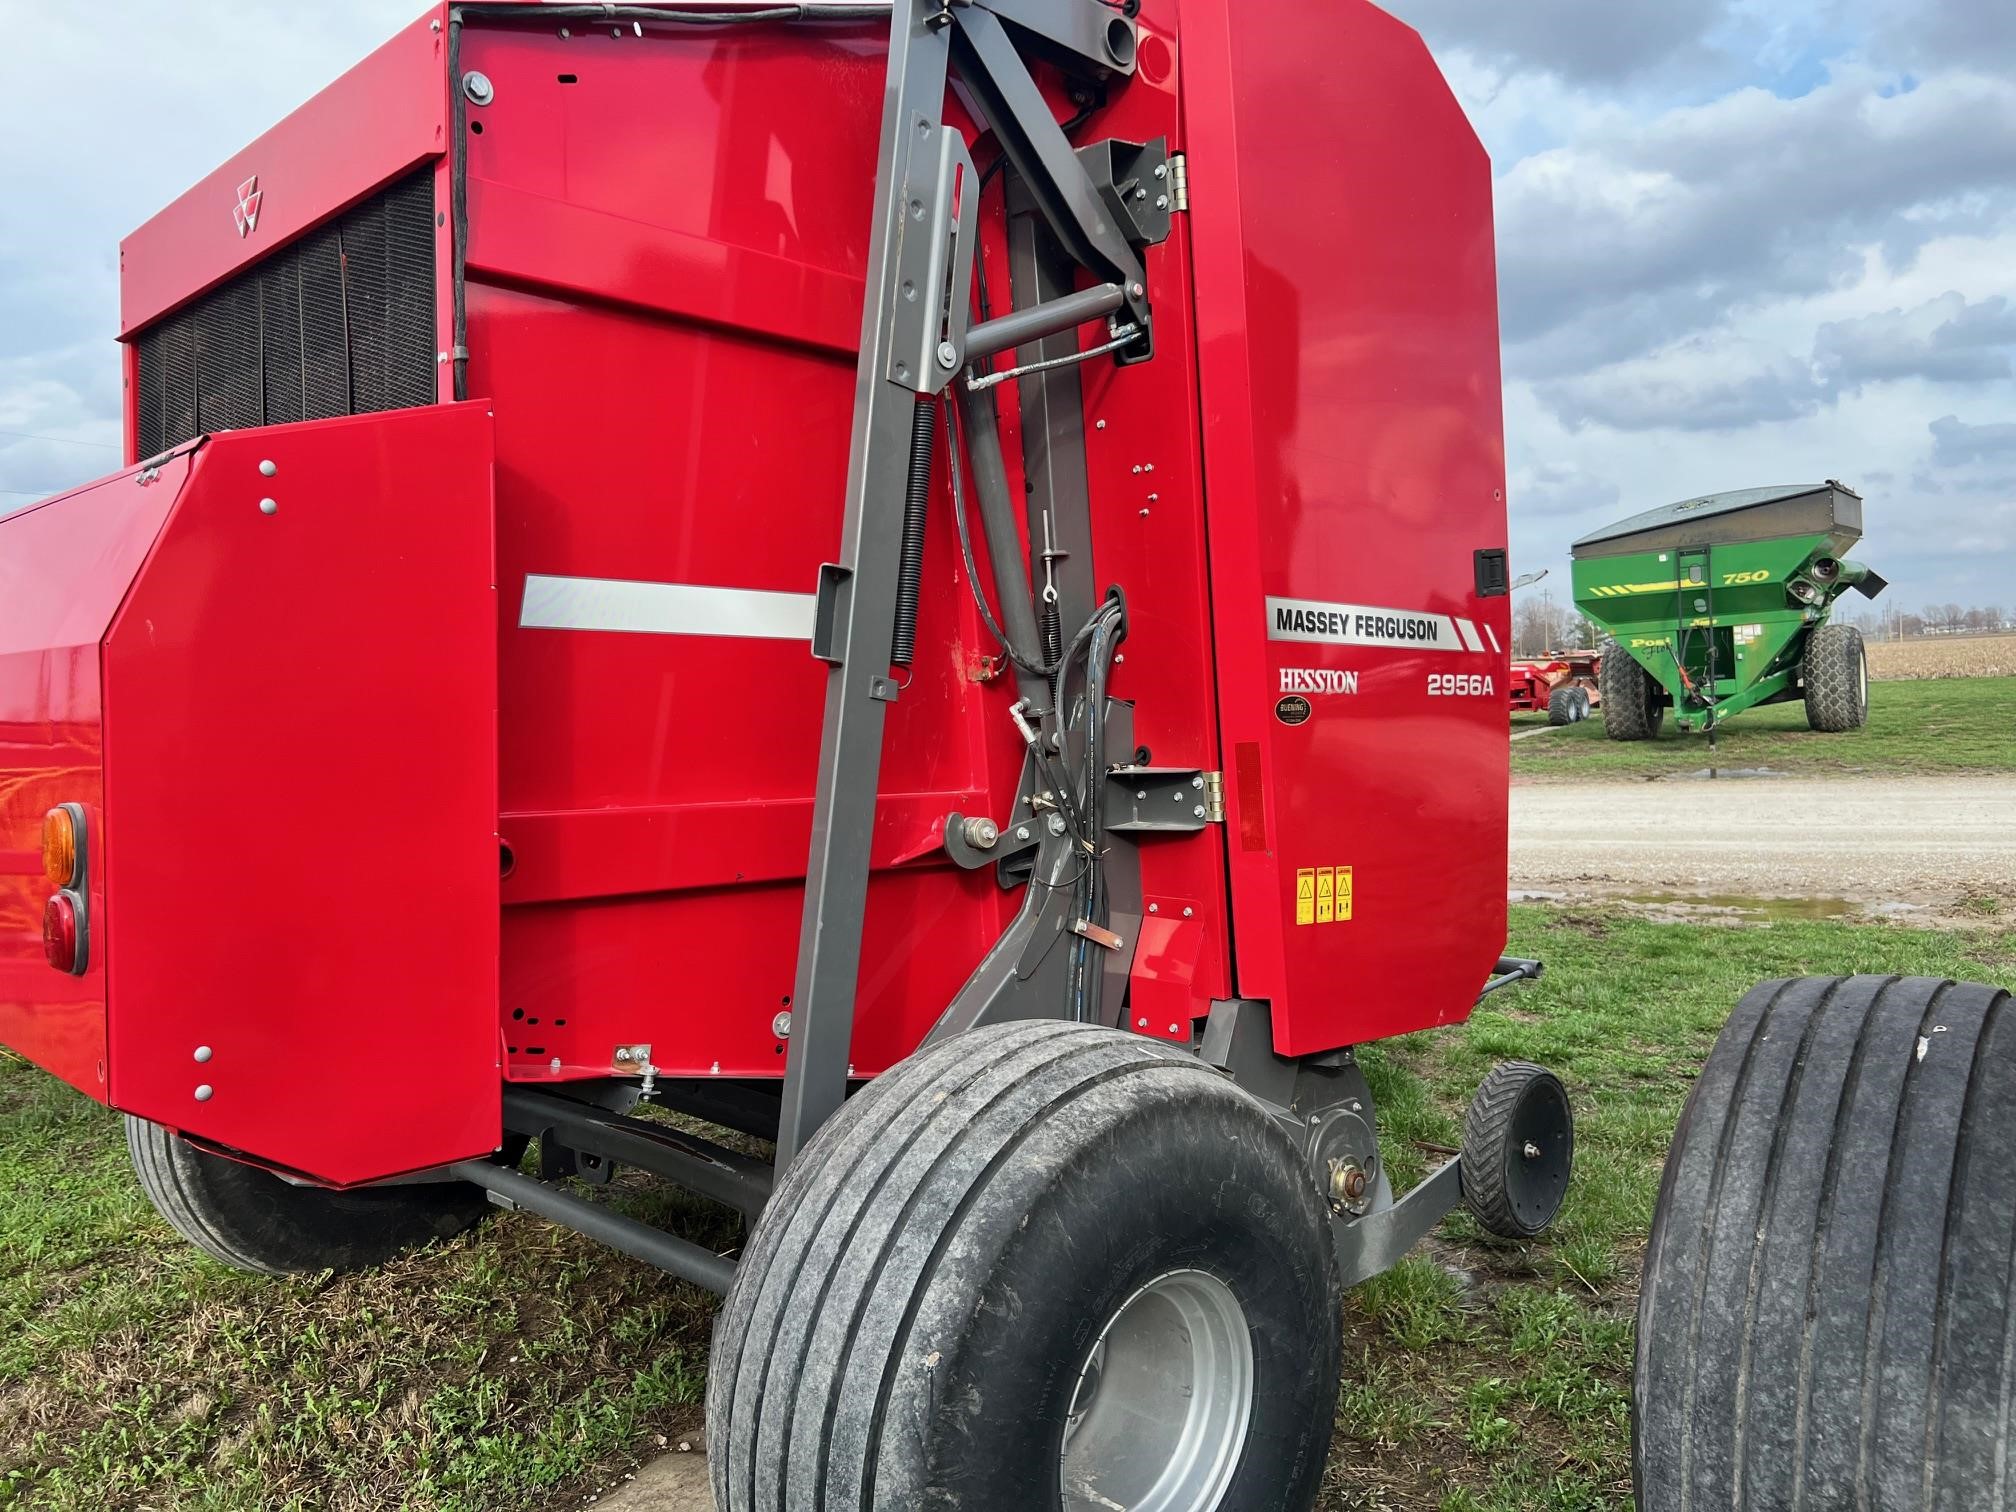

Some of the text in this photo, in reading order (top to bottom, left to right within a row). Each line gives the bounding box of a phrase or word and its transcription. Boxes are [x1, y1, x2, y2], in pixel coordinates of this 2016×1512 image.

[1722, 570, 1770, 585] 750
[1276, 608, 1438, 641] MASSEY FERGUSON
[1279, 668, 1359, 694] HESSTON
[1427, 673, 1494, 696] 2956A
